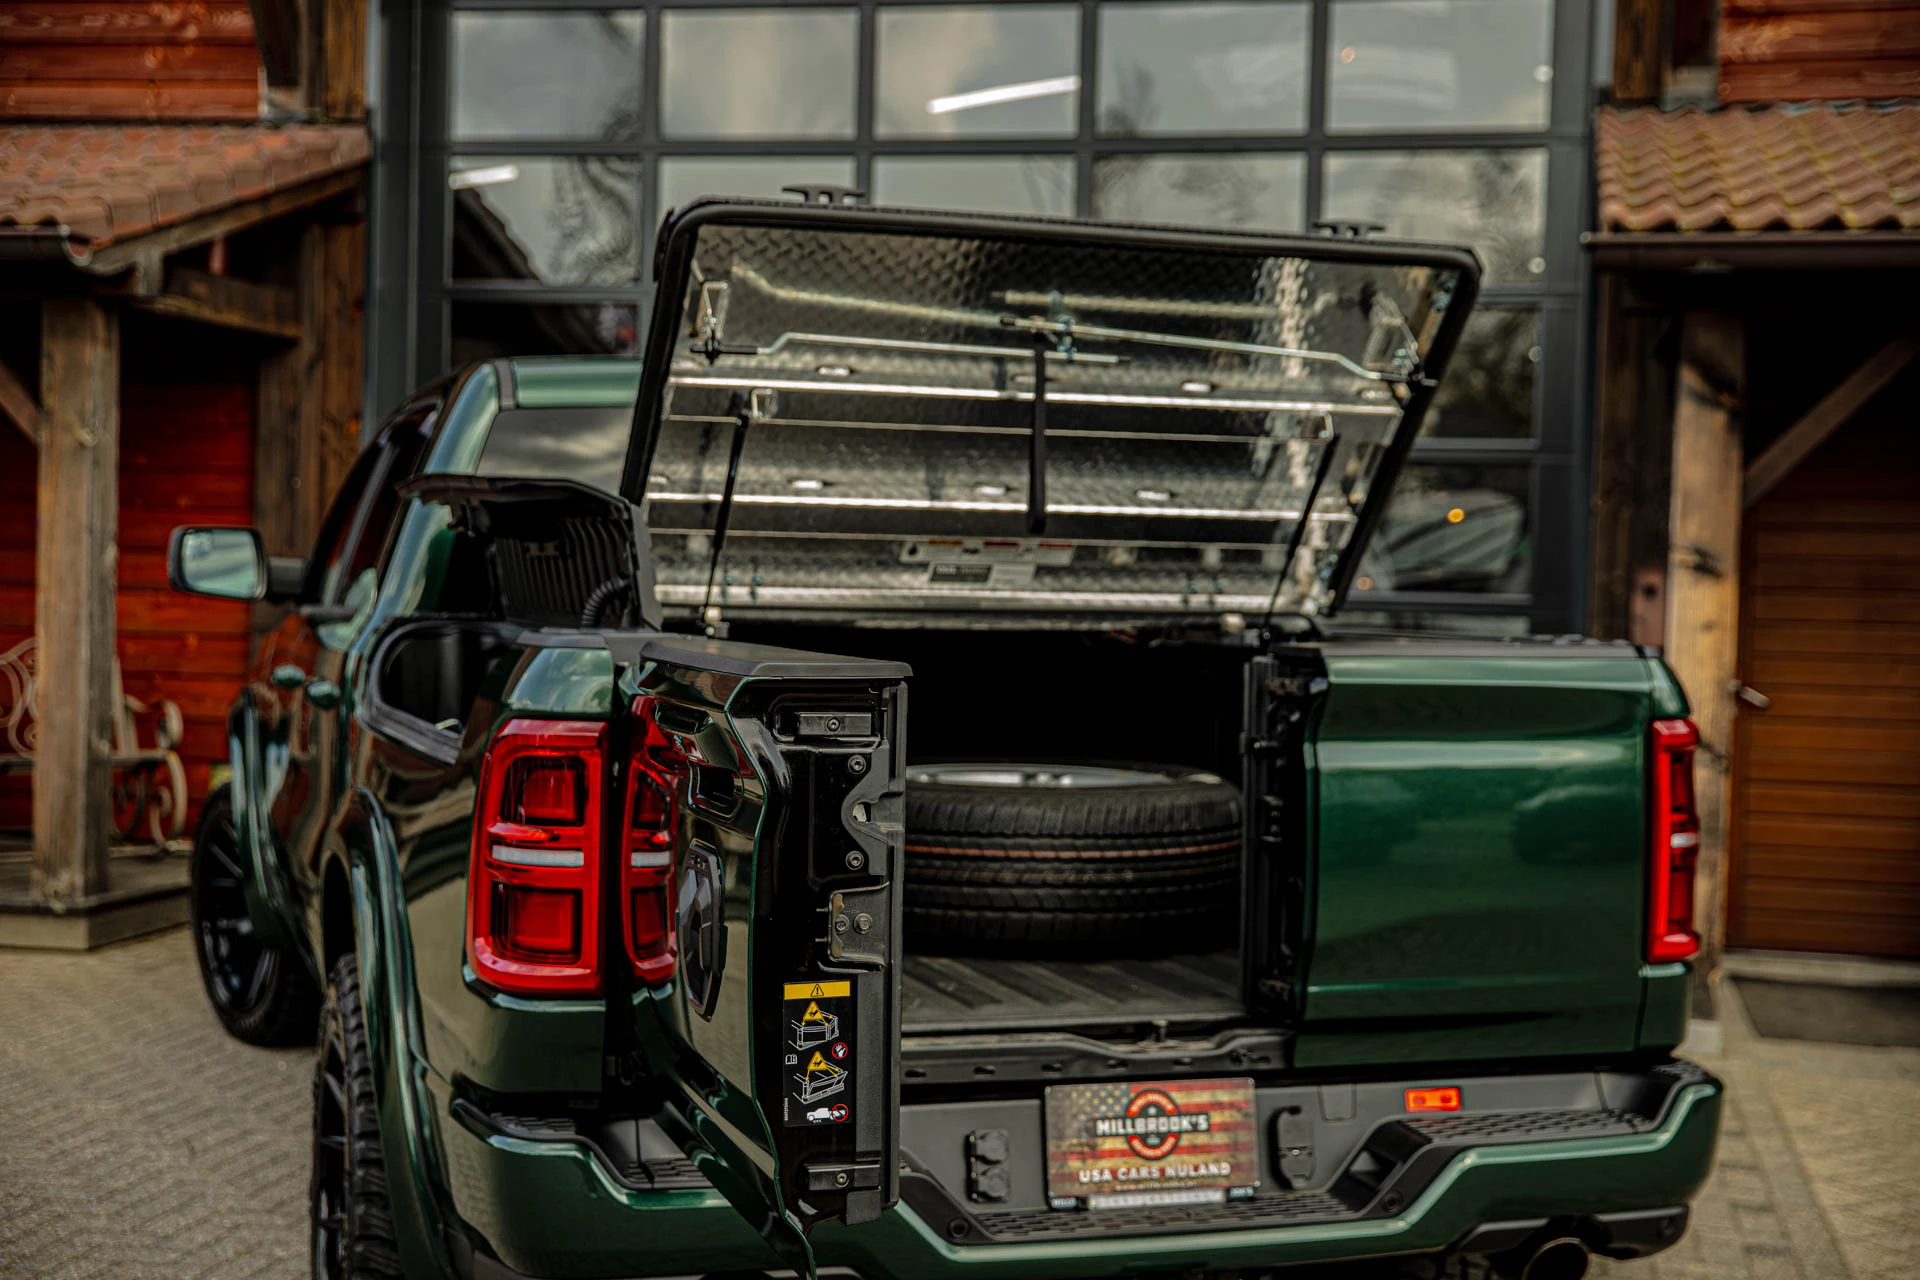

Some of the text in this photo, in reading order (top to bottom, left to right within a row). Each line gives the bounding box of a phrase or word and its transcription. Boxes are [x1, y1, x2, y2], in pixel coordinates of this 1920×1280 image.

[1096, 1114, 1209, 1136] MILLBROOK'S
[1079, 1161, 1231, 1184] USA CARS NULAND
